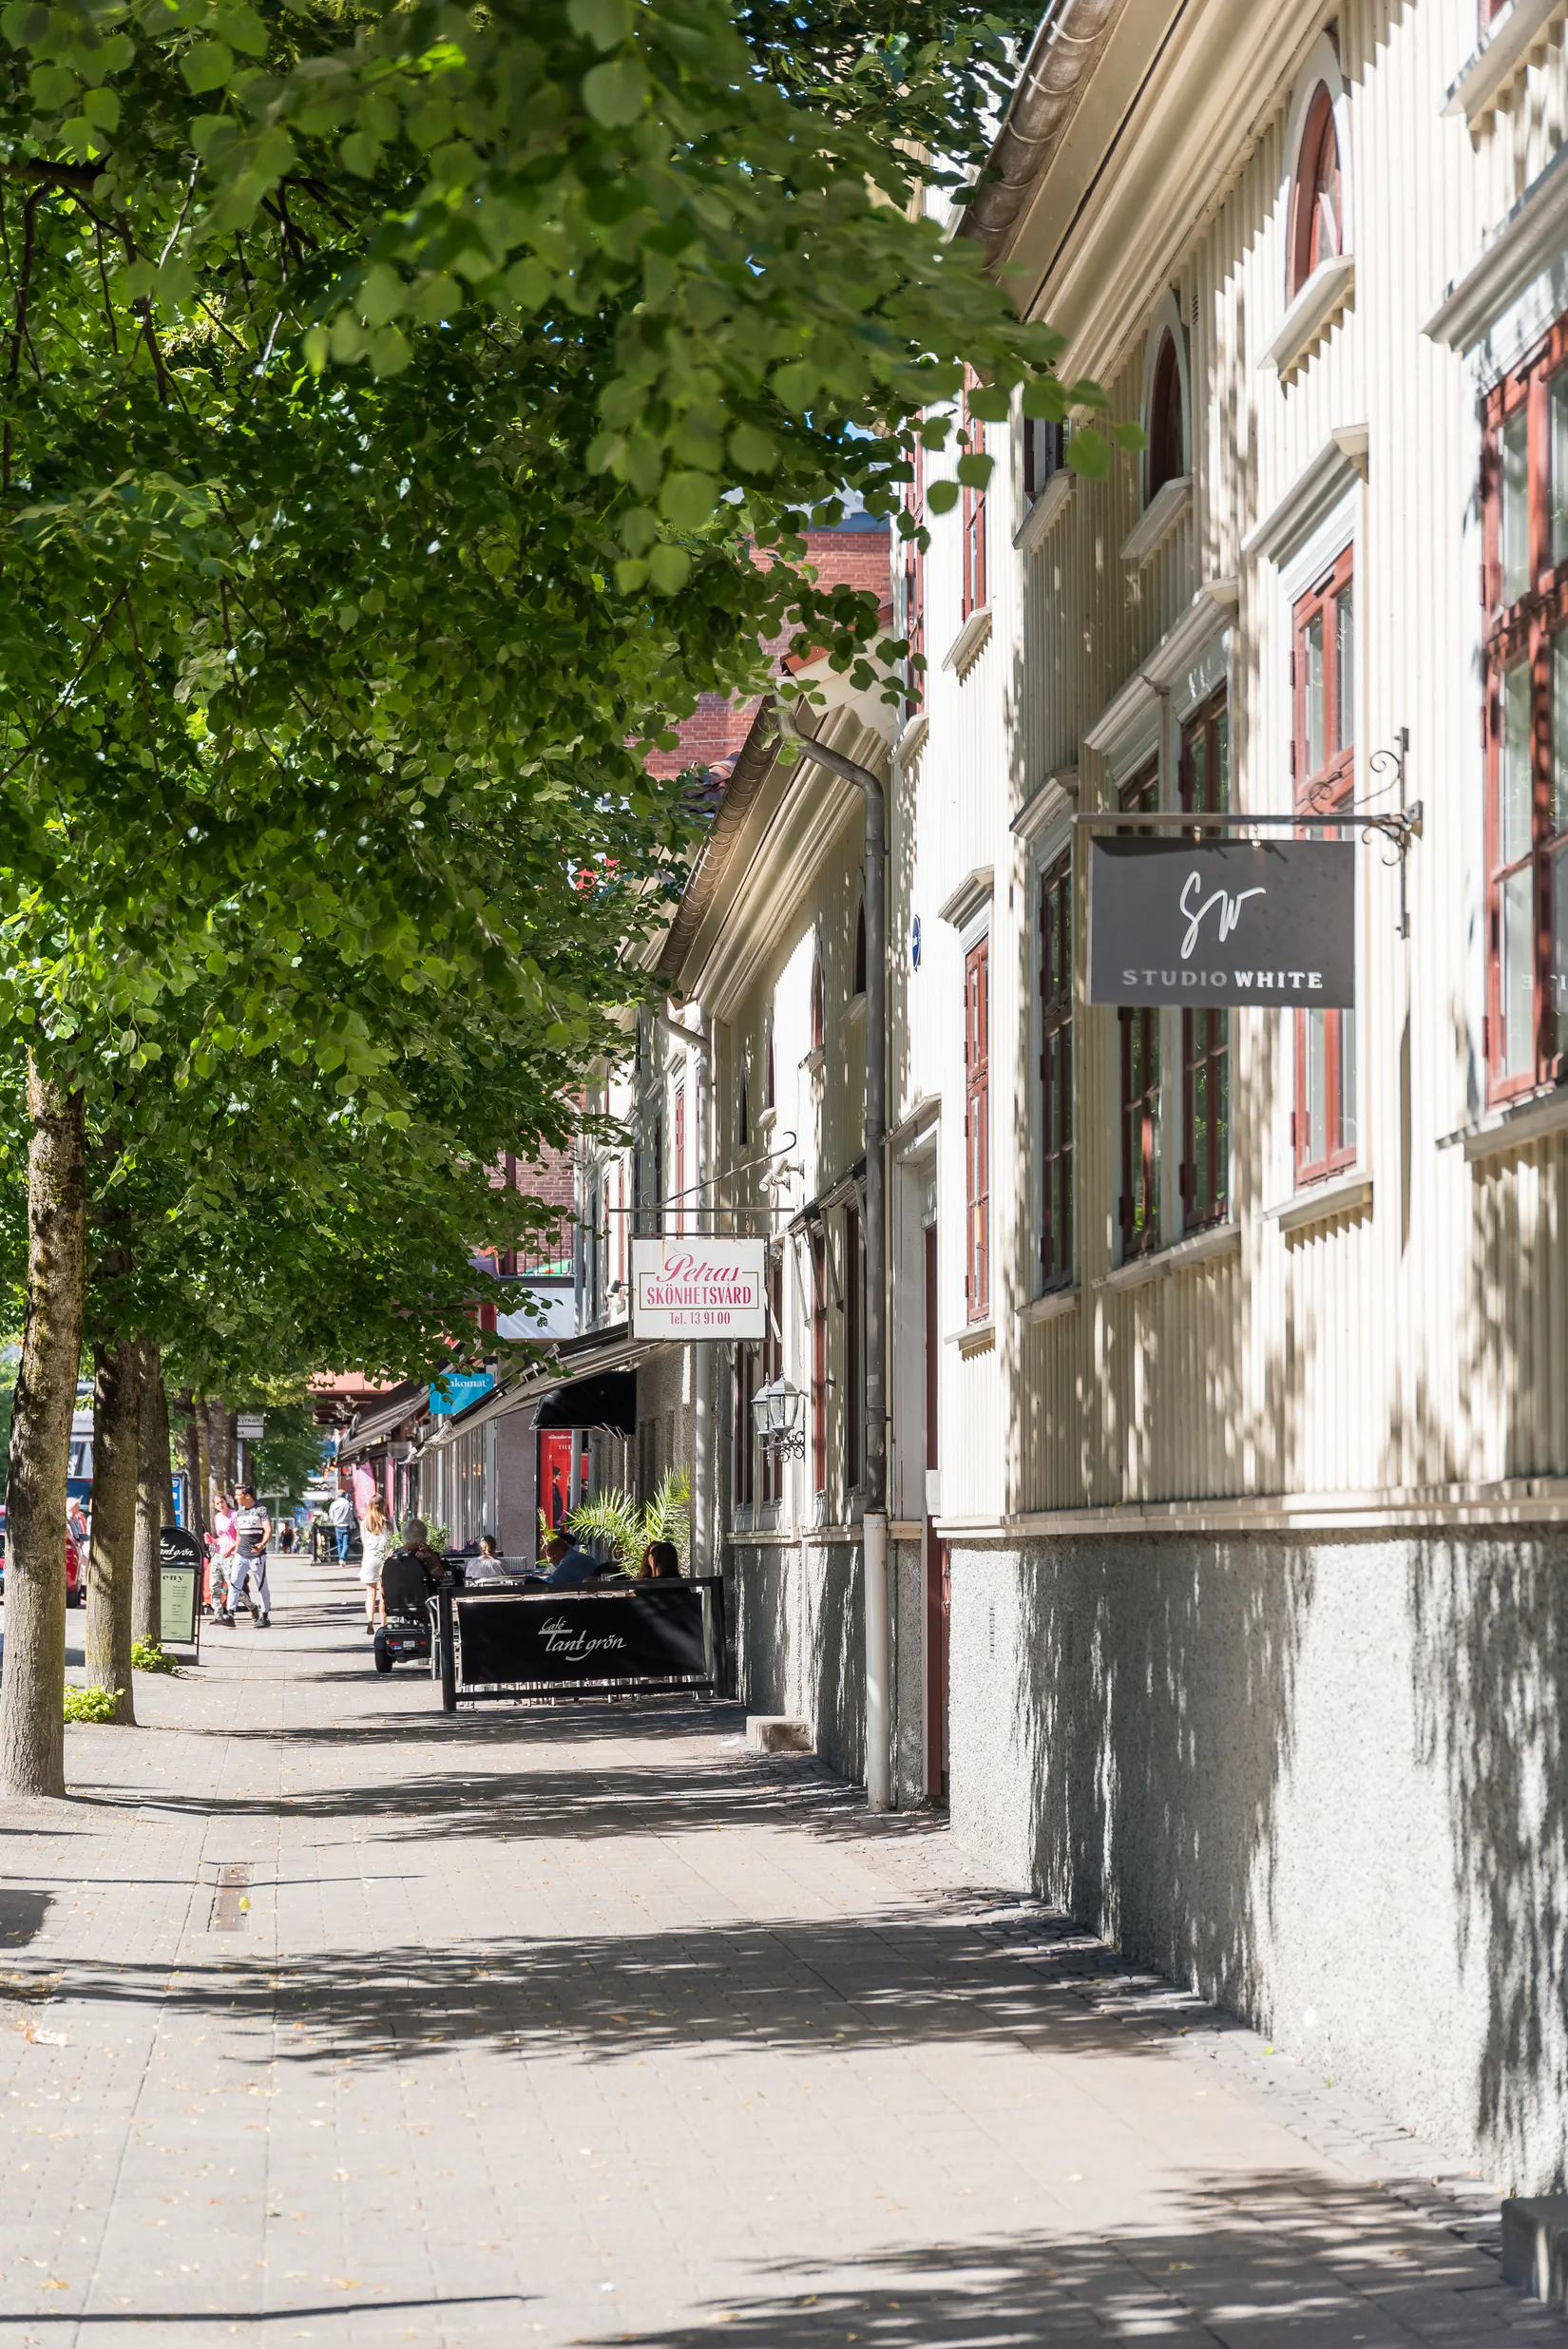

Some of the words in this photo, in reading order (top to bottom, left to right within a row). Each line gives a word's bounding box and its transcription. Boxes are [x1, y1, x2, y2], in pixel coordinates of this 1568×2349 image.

[1121, 968, 1228, 987] STUDIO
[1233, 969, 1324, 989] WHITE
[656, 1252, 741, 1283] Petras
[646, 1283, 752, 1305] SKÖNHETSVÅRD
[669, 1311, 687, 1325] Tel.
[448, 1377, 487, 1387] nkomat
[163, 1575, 184, 1583] eny
[541, 1615, 566, 1631] Café
[538, 1629, 587, 1652] Tant
[565, 1633, 627, 1662] grön
